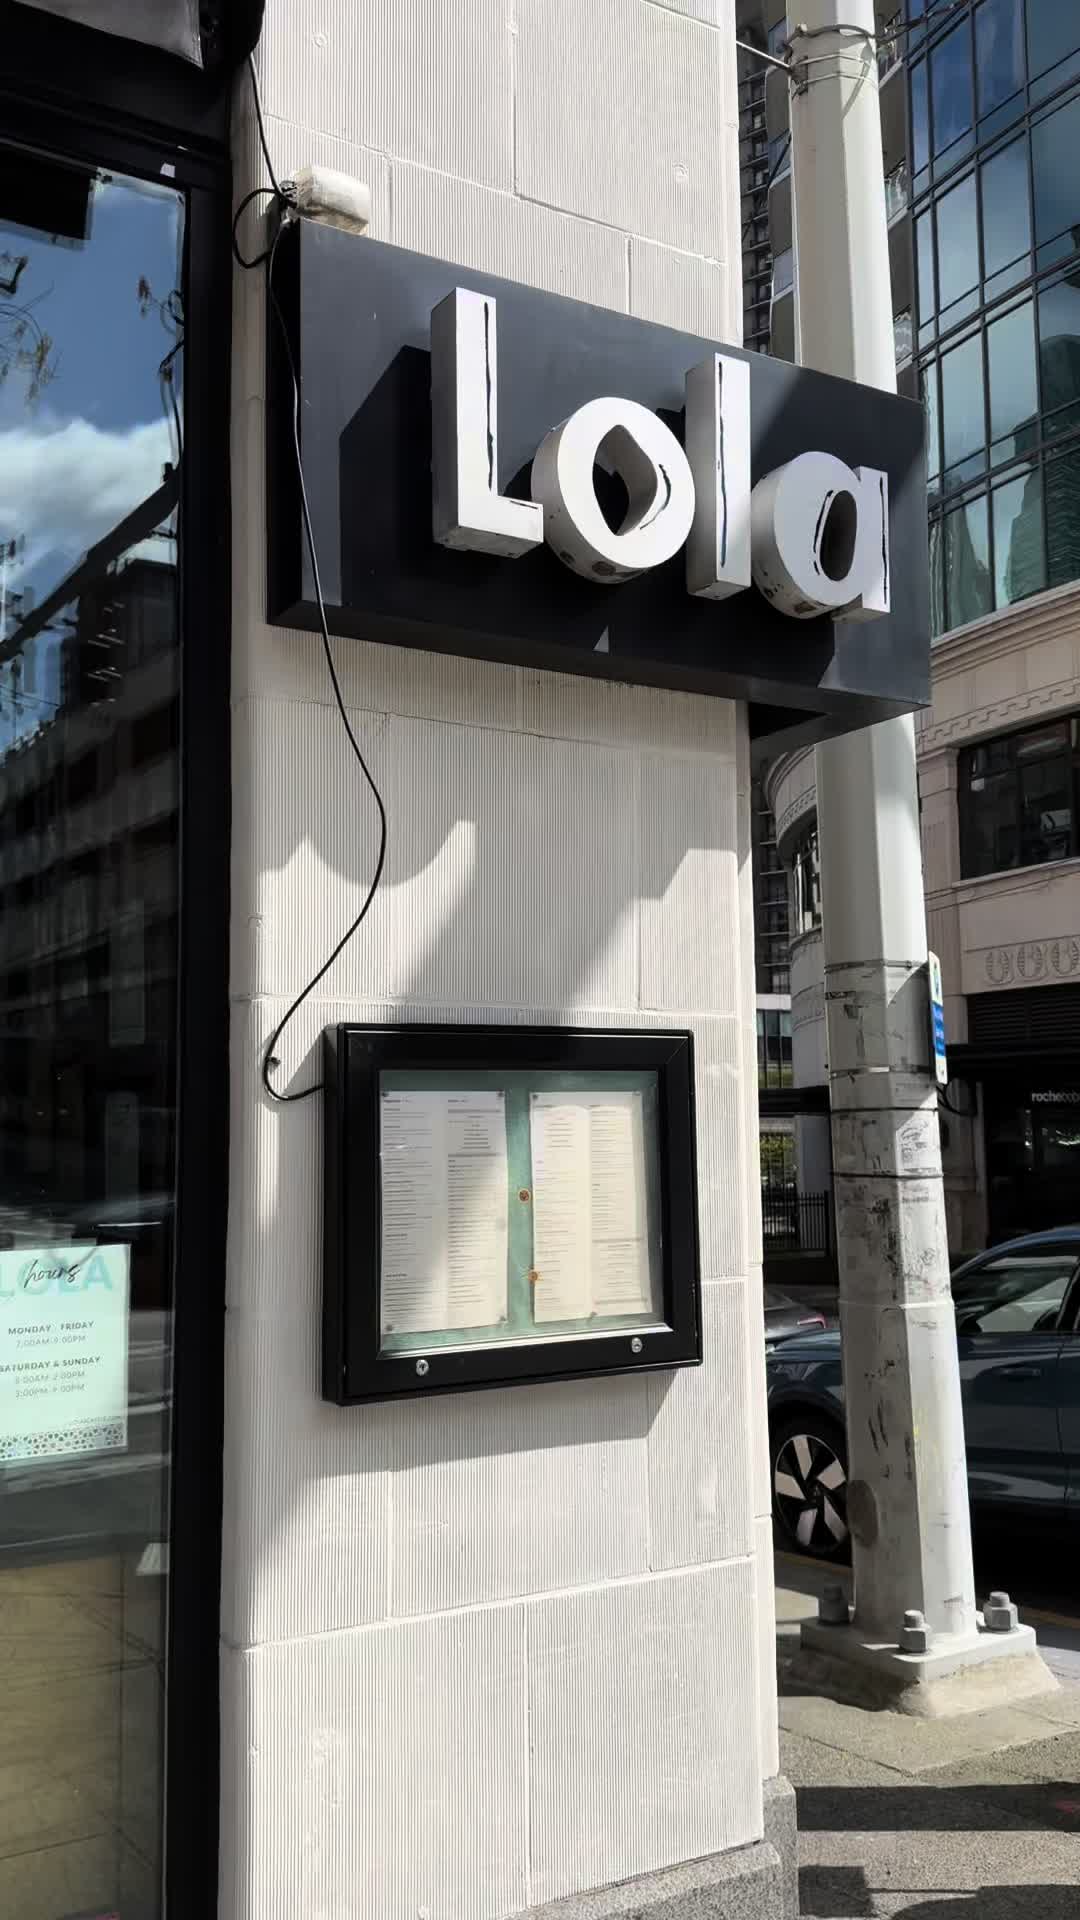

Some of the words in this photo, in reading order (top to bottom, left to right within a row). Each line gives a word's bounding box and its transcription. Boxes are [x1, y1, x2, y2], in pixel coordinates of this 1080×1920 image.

[23, 1258, 81, 1289] hours
[8, 1325, 52, 1335] MONDAY
[60, 1321, 94, 1331] FRIDAY
[0, 1361, 51, 1372] SATURDAY
[63, 1356, 101, 1367] SUNDAY
